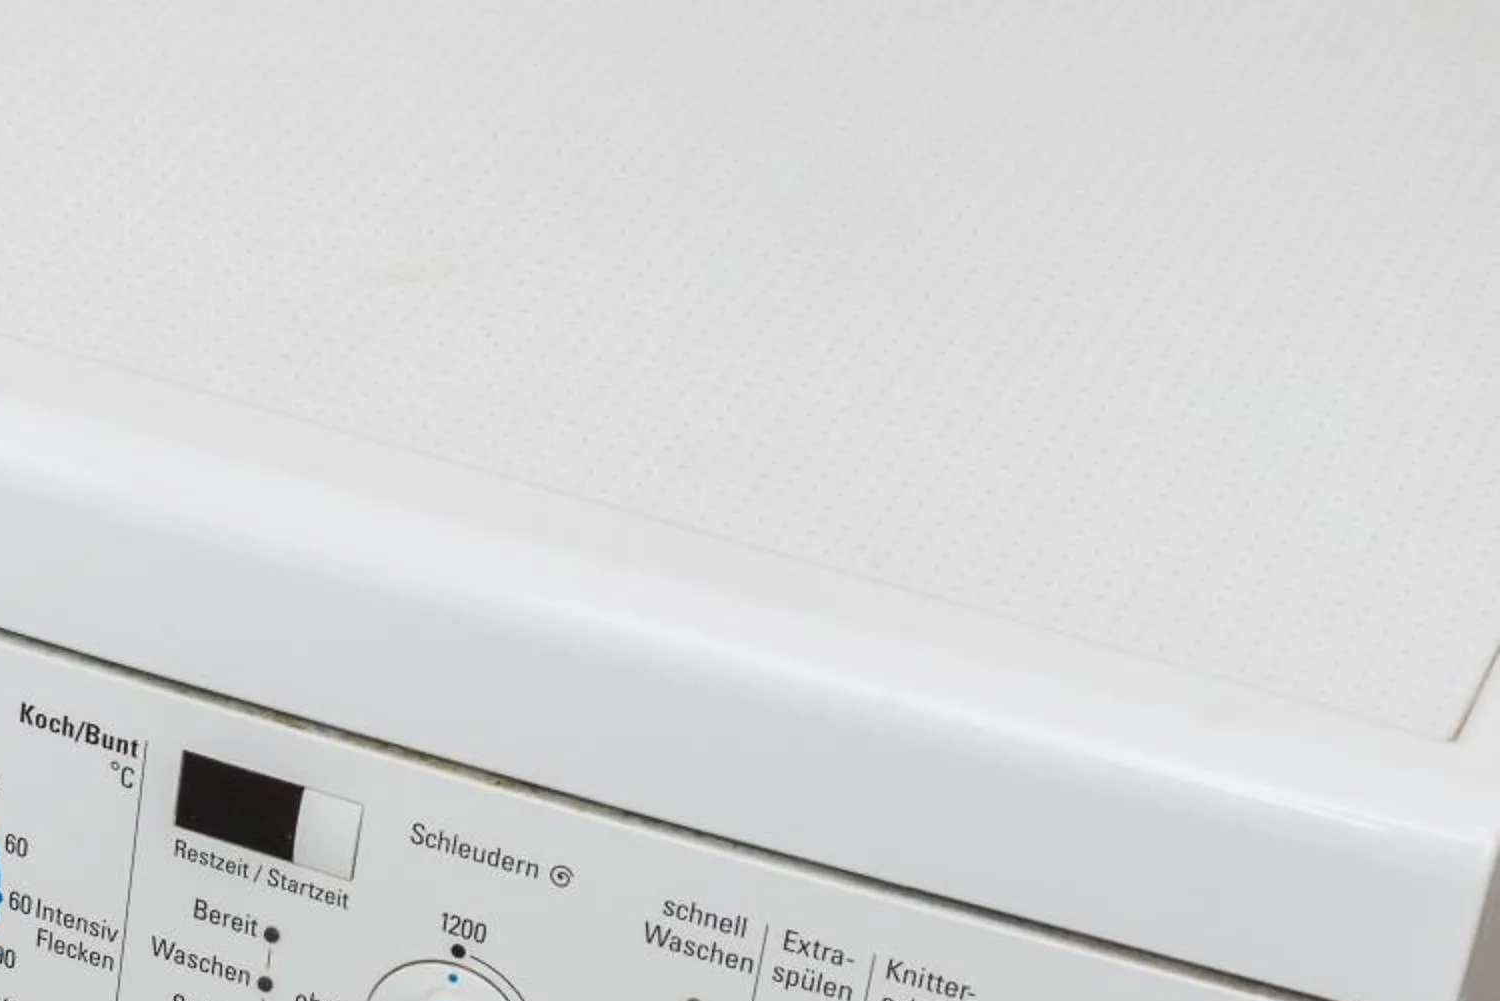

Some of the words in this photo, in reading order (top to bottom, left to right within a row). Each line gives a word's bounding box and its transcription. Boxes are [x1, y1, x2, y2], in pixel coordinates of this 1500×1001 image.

[19, 702, 139, 758] Koch/Bunt
[110, 761, 136, 789] °C
[5, 835, 28, 857] 60
[410, 823, 539, 879] Schleudern
[175, 840, 249, 879] Restzeit
[267, 867, 350, 910] Startzeit
[9, 892, 32, 915] 60
[36, 900, 119, 942] Intensiv
[193, 899, 258, 937] Bereit
[440, 912, 487, 943] 1200
[662, 899, 748, 938] schnell
[36, 929, 114, 971] Flecken
[151, 936, 251, 986] Waschen
[643, 922, 754, 975] Waschen
[782, 929, 855, 968] Extra-
[772, 961, 853, 1001] spülen
[886, 958, 977, 1001] Knitter-
